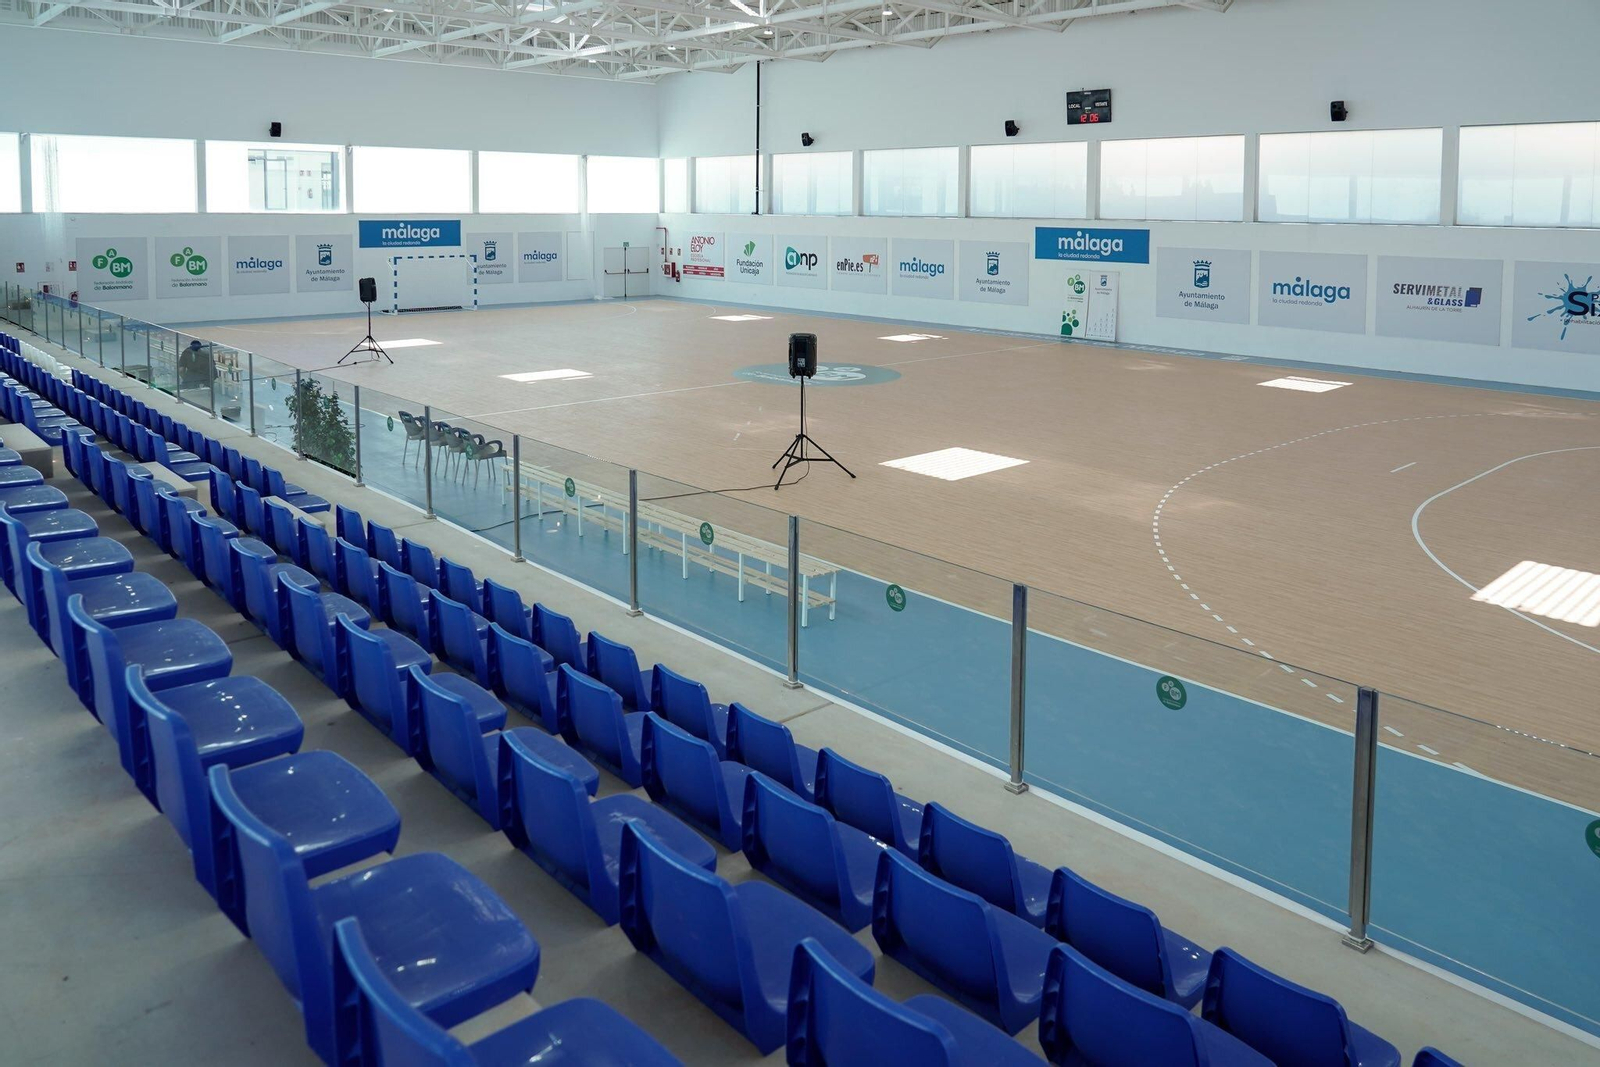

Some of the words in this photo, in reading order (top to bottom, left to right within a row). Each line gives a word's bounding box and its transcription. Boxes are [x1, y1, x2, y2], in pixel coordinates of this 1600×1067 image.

[691, 236, 716, 245] ANTONIO
[736, 258, 764, 268] Fundación
[836, 258, 864, 272] enPie.es
[740, 267, 760, 276] Unicaja
[975, 278, 1011, 286] Ayuntamiento
[1392, 282, 1463, 298] SERVIMETAL
[1178, 291, 1226, 300] Ayuntamiento
[1193, 300, 1219, 310] Málaga
[1298, 299, 1323, 307] redonda
[1427, 297, 1464, 307] &GLASS
